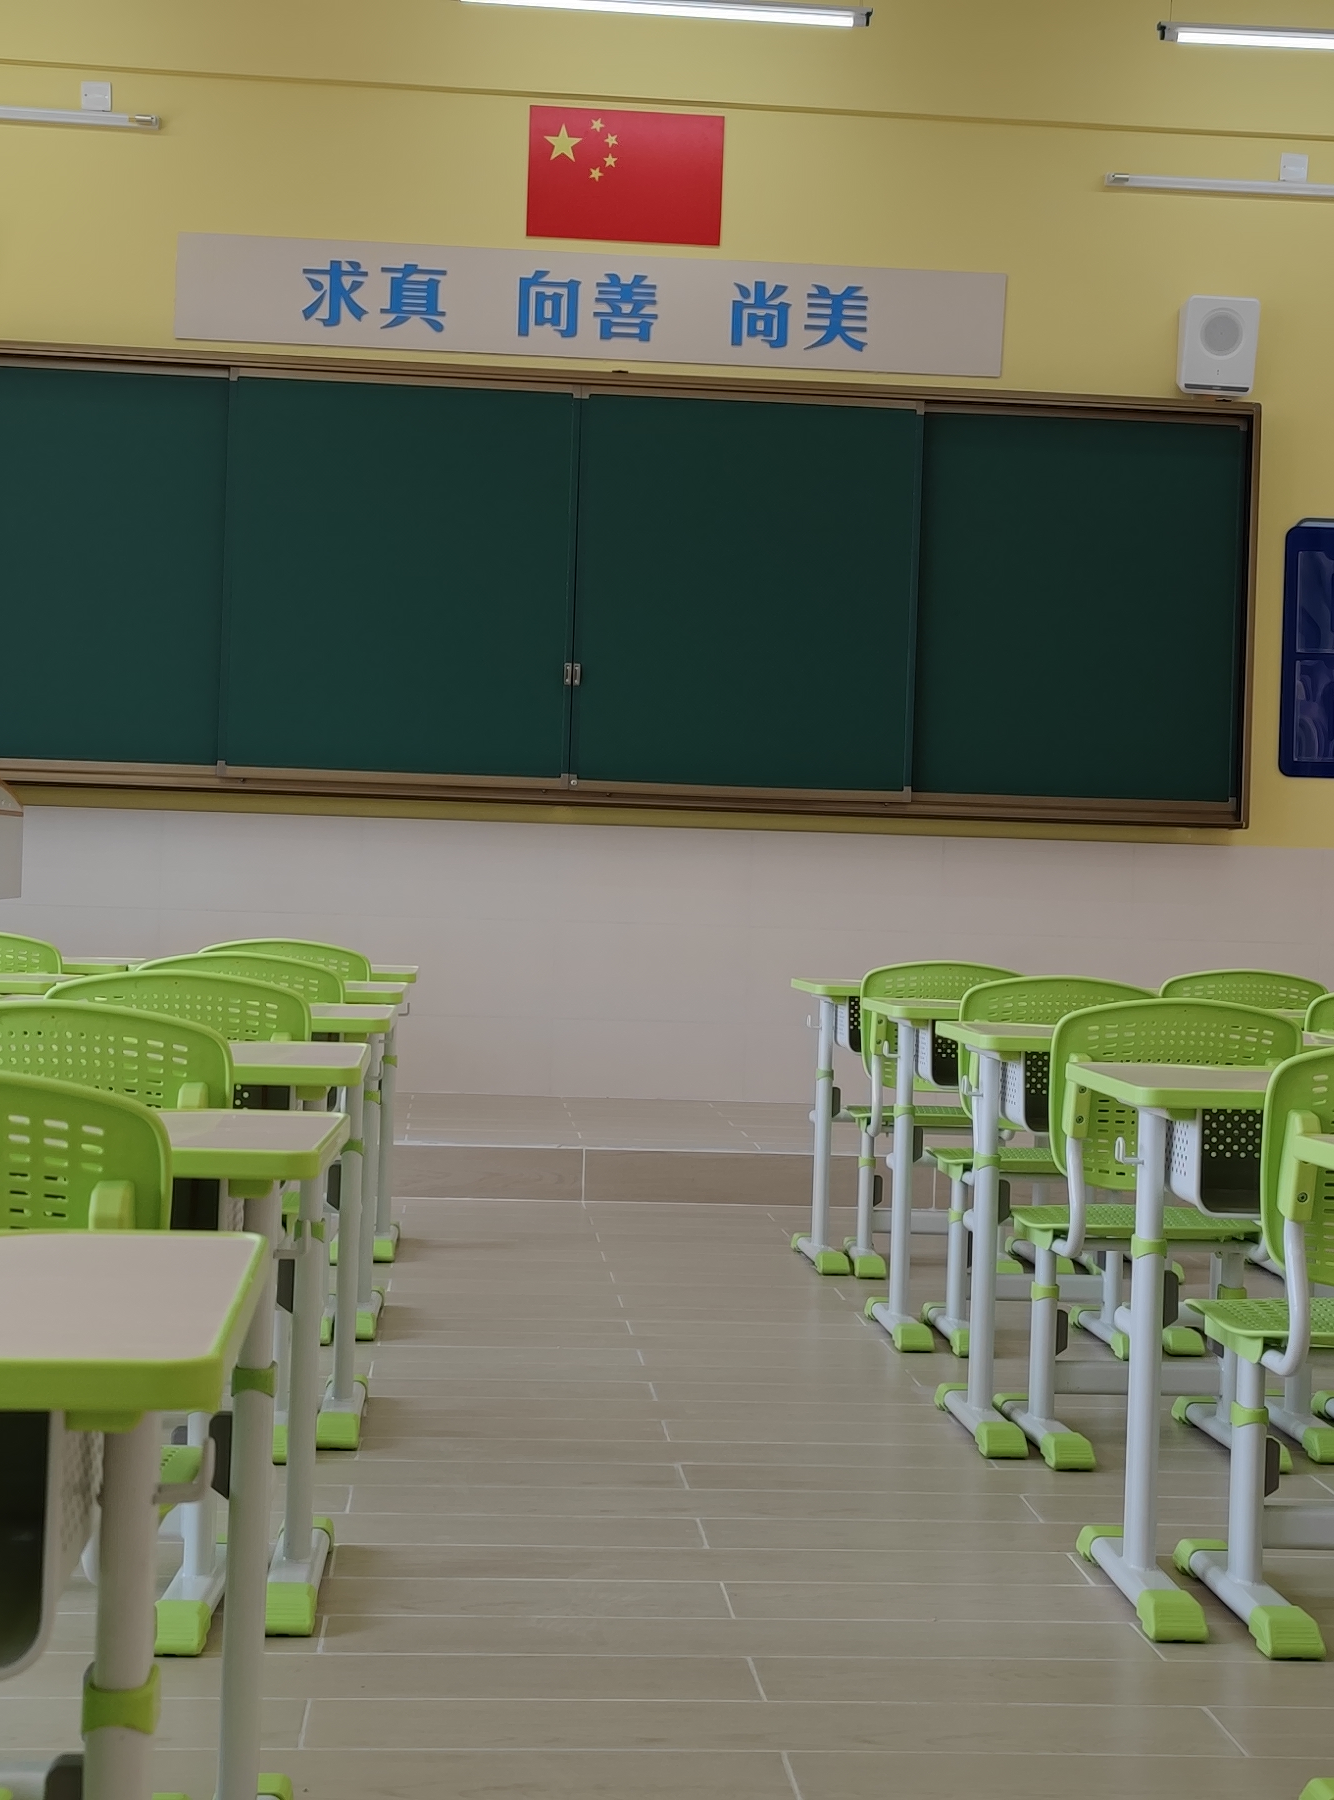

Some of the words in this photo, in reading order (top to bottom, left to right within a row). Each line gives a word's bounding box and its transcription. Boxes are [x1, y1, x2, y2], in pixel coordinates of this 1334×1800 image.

[301, 259, 449, 332] 求真
[517, 269, 659, 343] 向善
[731, 280, 871, 353] 尚美
